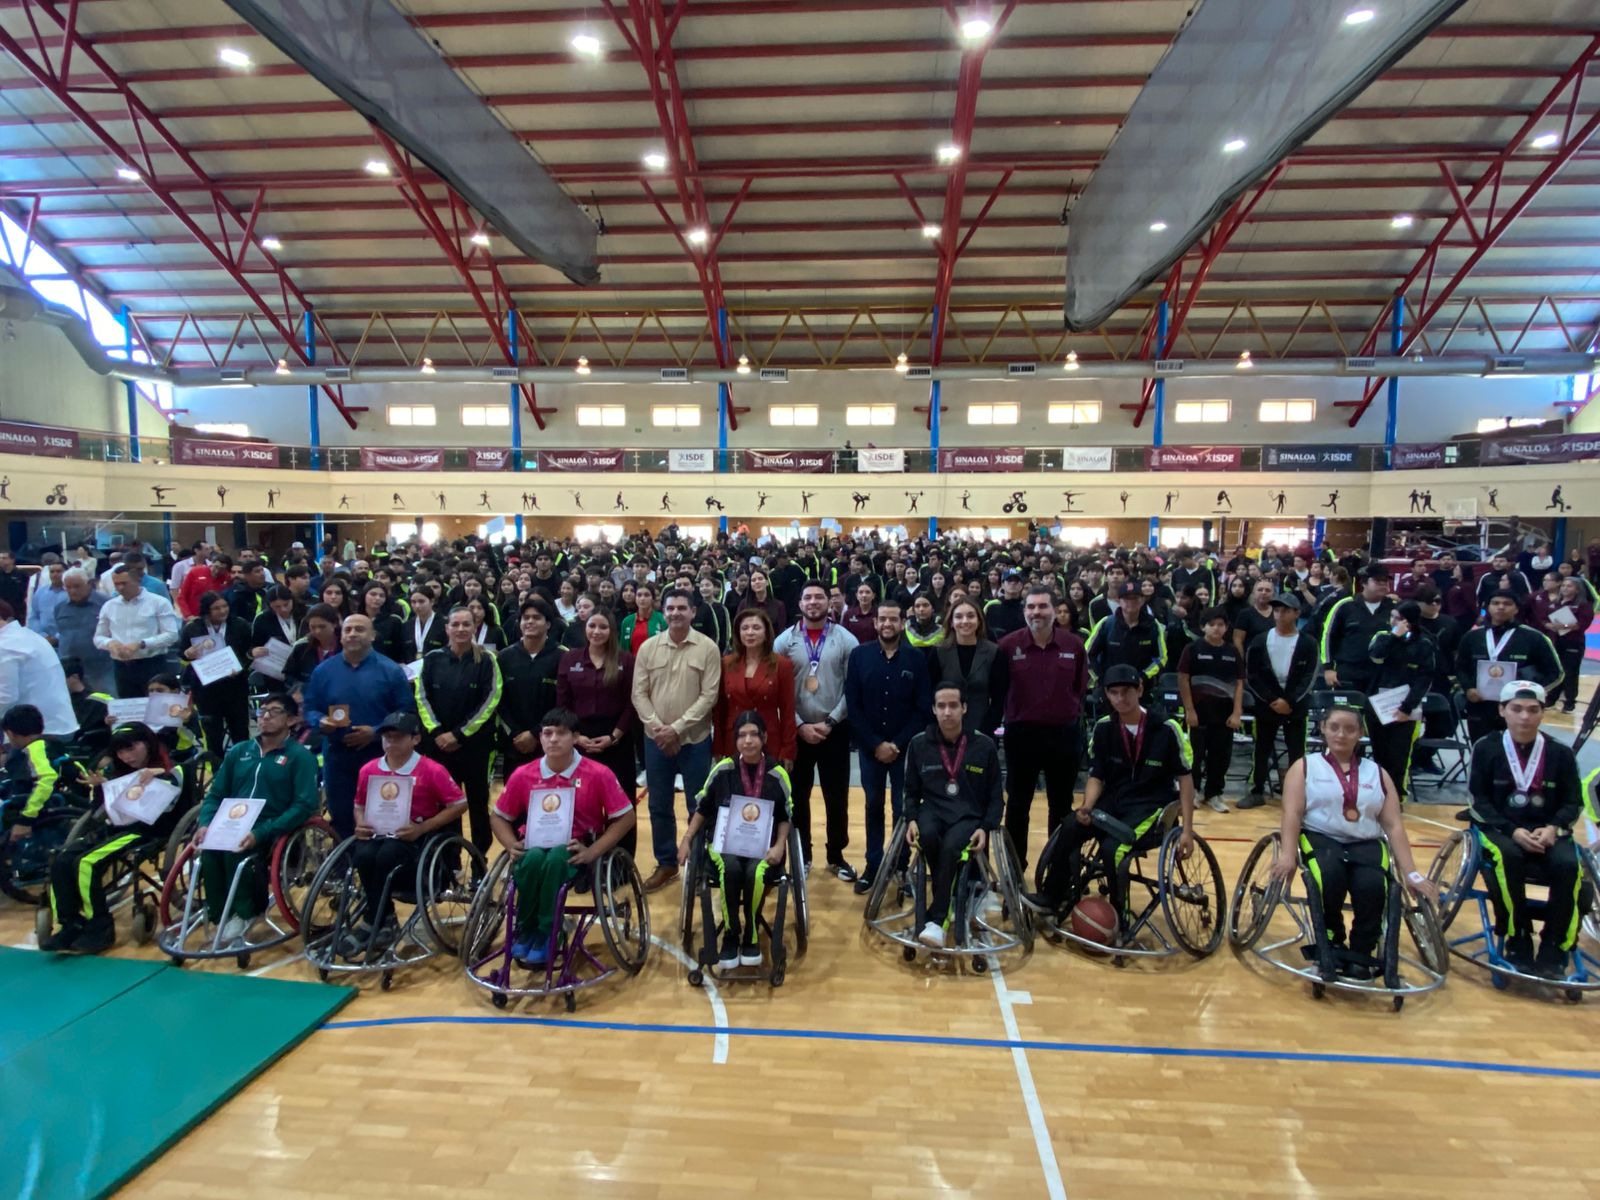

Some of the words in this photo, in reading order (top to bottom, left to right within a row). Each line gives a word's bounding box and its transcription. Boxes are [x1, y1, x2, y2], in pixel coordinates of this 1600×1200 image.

[51, 437, 73, 448] ISDE
[1503, 445, 1549, 453] SINALOA
[1572, 442, 1600, 452] ISDE
[195, 448, 235, 457] SINALOA
[250, 451, 272, 460] ISDE
[483, 451, 502, 459] ISDE
[685, 453, 704, 461] ISDE
[1162, 454, 1198, 462] SINALOA
[1212, 454, 1234, 462] ISDE
[1330, 453, 1352, 462] ISDE
[1406, 452, 1441, 460] SINALOA
[420, 455, 439, 463] ISDE
[557, 457, 587, 465] SINALOA
[598, 457, 616, 465] ISDE
[806, 458, 823, 466] ISDE
[1002, 455, 1022, 464] ISDE
